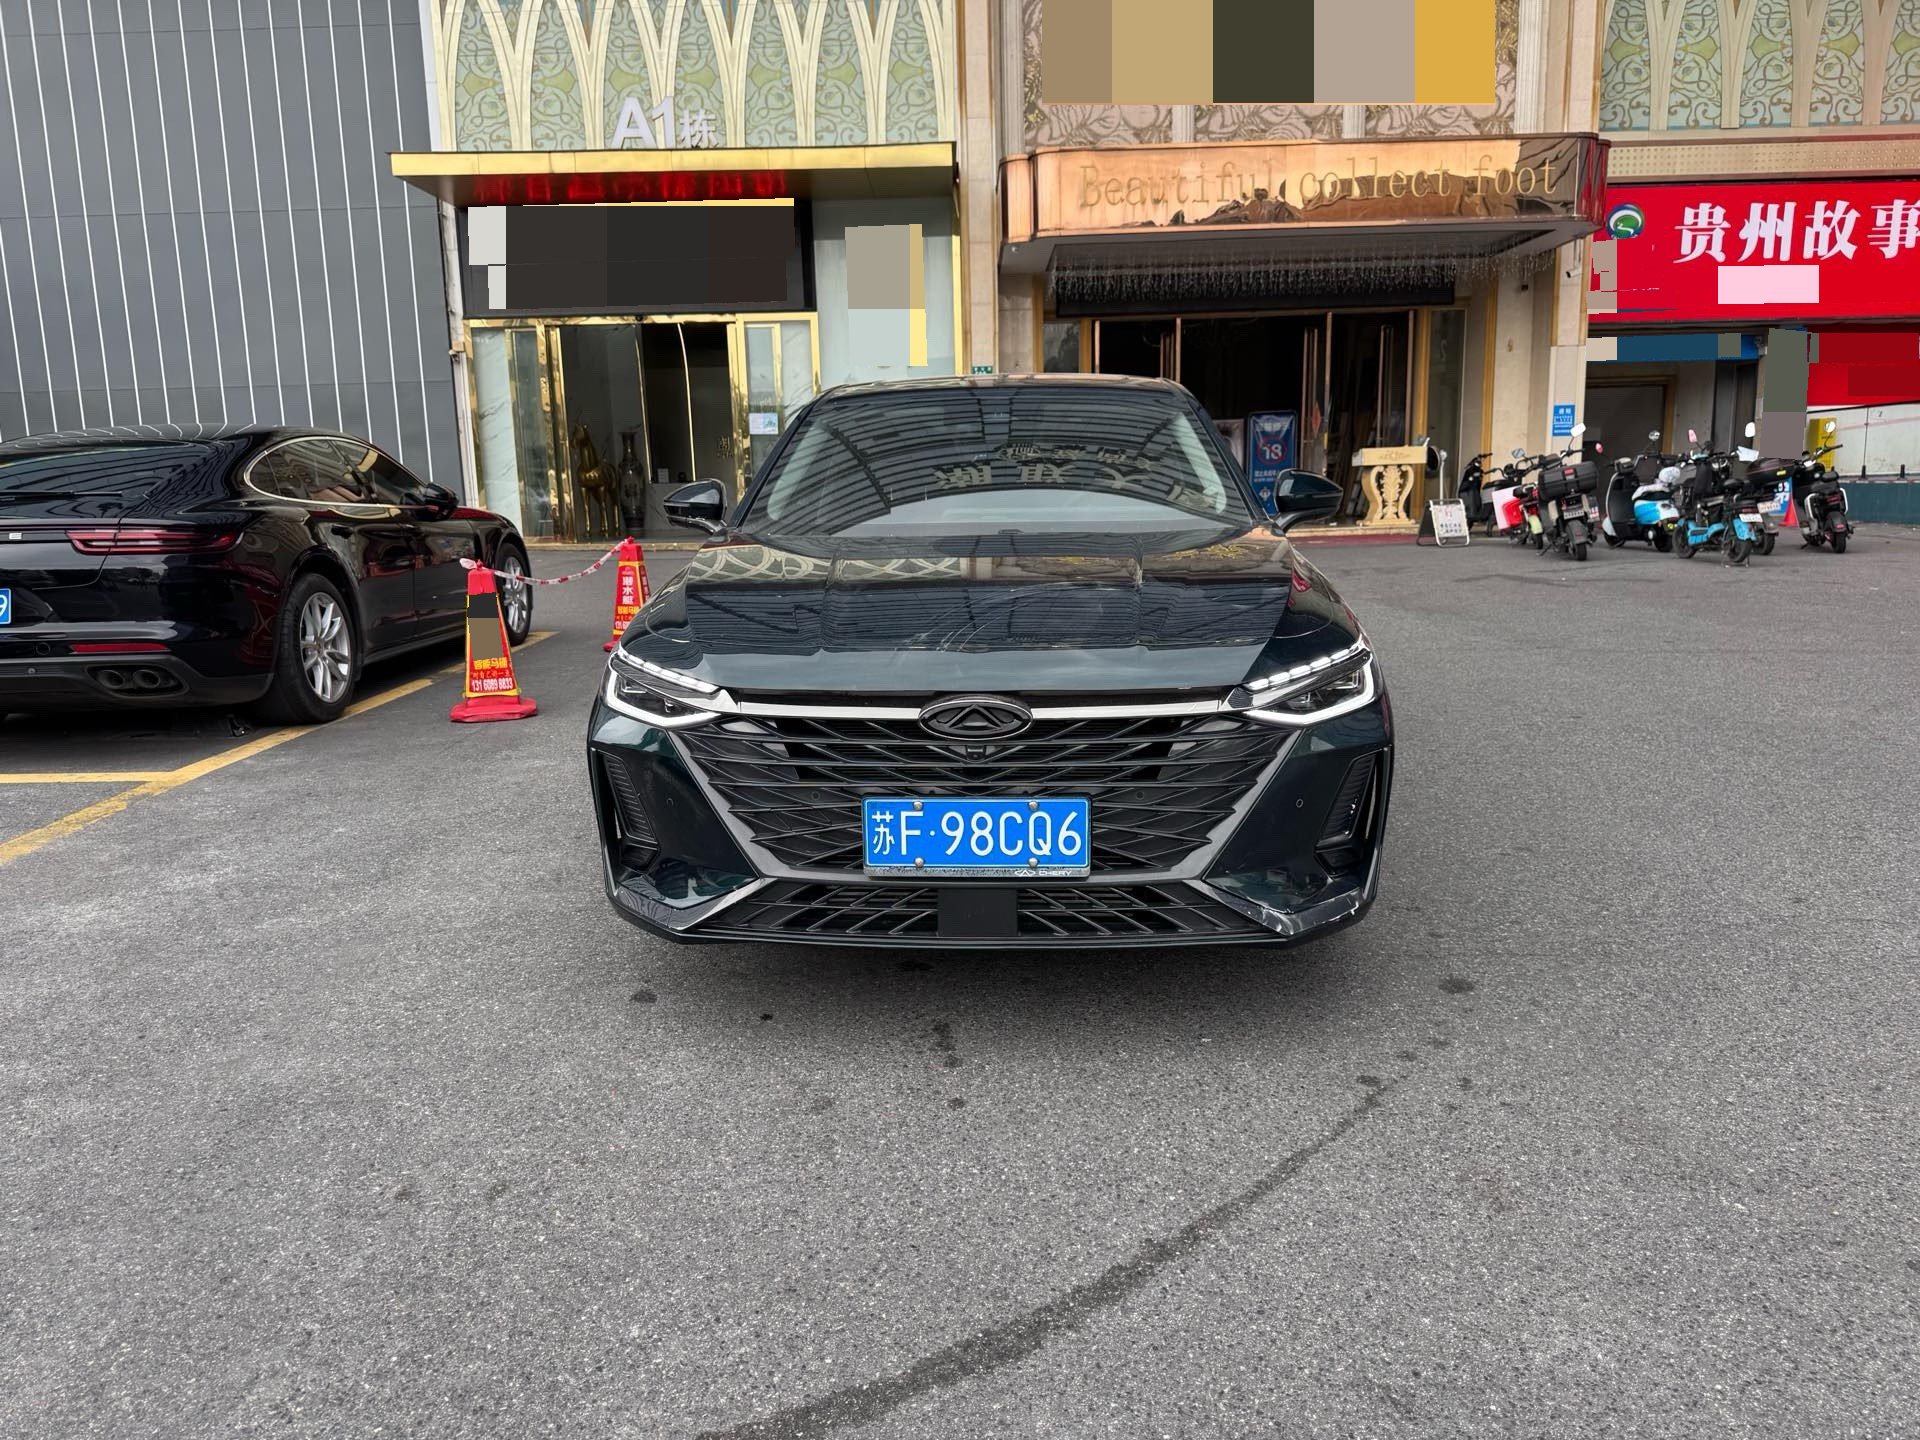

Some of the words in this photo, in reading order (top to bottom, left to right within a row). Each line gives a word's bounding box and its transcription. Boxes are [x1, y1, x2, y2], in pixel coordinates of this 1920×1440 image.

[610, 96, 719, 149] A1栋
[1079, 158, 1274, 208] Beautiful
[1299, 156, 1452, 203] collect
[1473, 154, 1556, 196] foot
[1673, 199, 1920, 264] 贵州故事
[471, 679, 483, 692] 131
[872, 810, 1082, 856] 苏F·98CQ6
